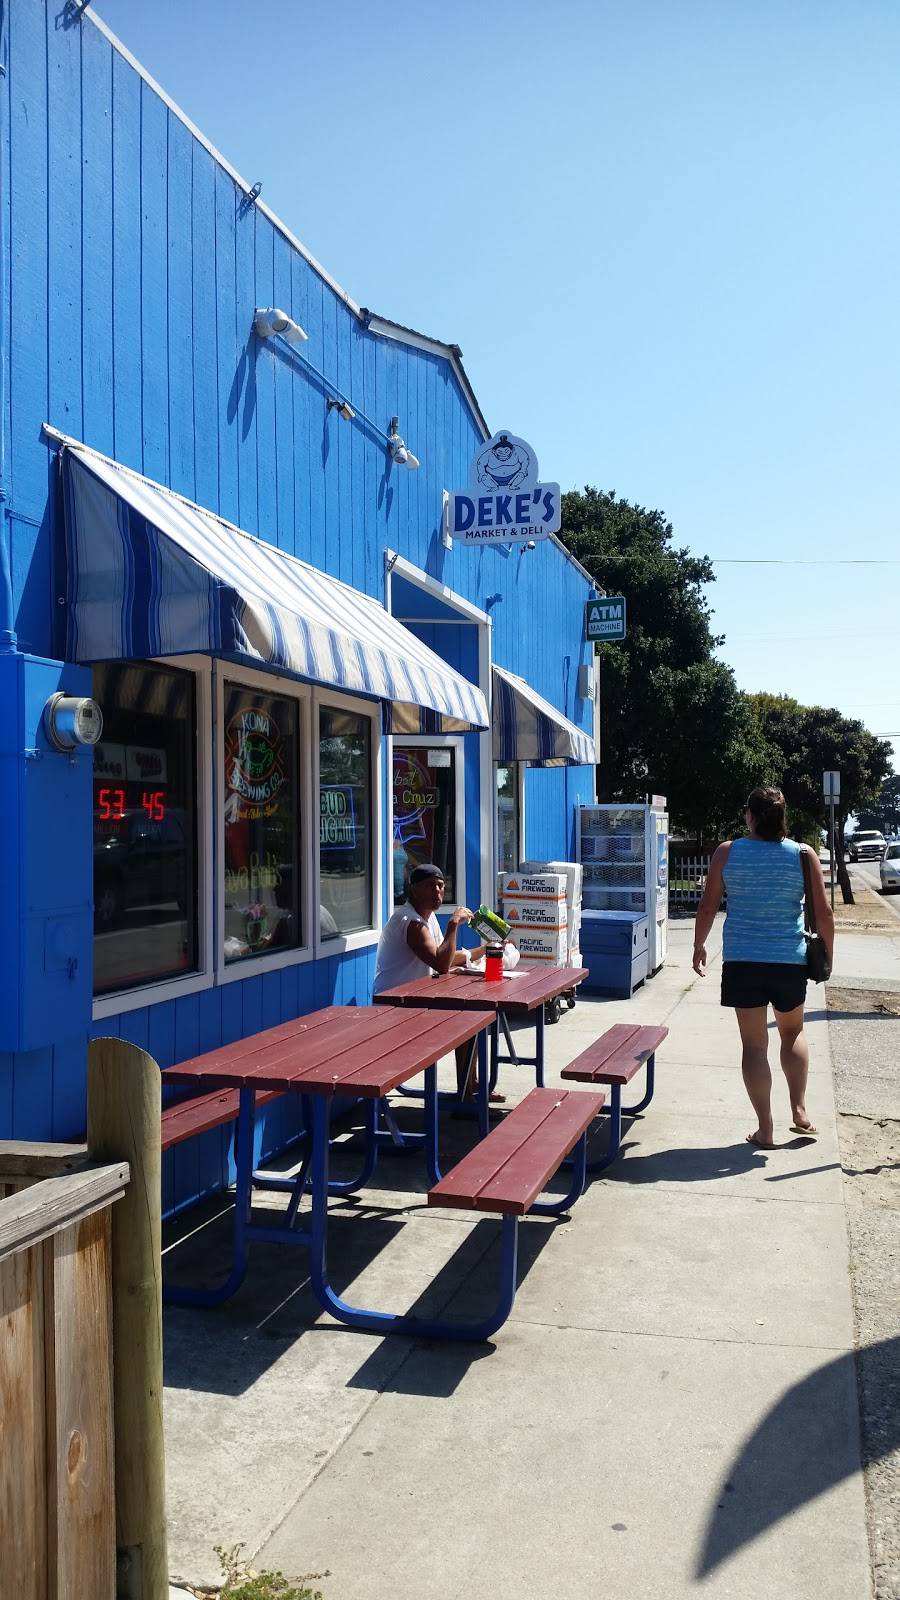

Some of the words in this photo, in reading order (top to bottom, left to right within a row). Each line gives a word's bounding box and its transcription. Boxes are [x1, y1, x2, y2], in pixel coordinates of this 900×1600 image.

[454, 489, 554, 531] DEKE'S
[465, 529, 507, 539] MARKET
[510, 527, 518, 536] &
[520, 525, 543, 536] DELI
[589, 604, 622, 621] ATM
[590, 623, 621, 632] MACHINE
[241, 711, 271, 737] KONA
[402, 788, 434, 804] Cruz
[98, 788, 126, 820] 53
[142, 792, 165, 821] 45
[320, 817, 352, 843] IGHT
[521, 878, 546, 886] PACIFIC
[521, 885, 555, 893] FIREWOOD
[522, 908, 546, 916] PACIFIC
[522, 915, 556, 923] FIREWOOD
[519, 938, 544, 946] PACIFIC
[519, 945, 553, 953] FIREWOOD
